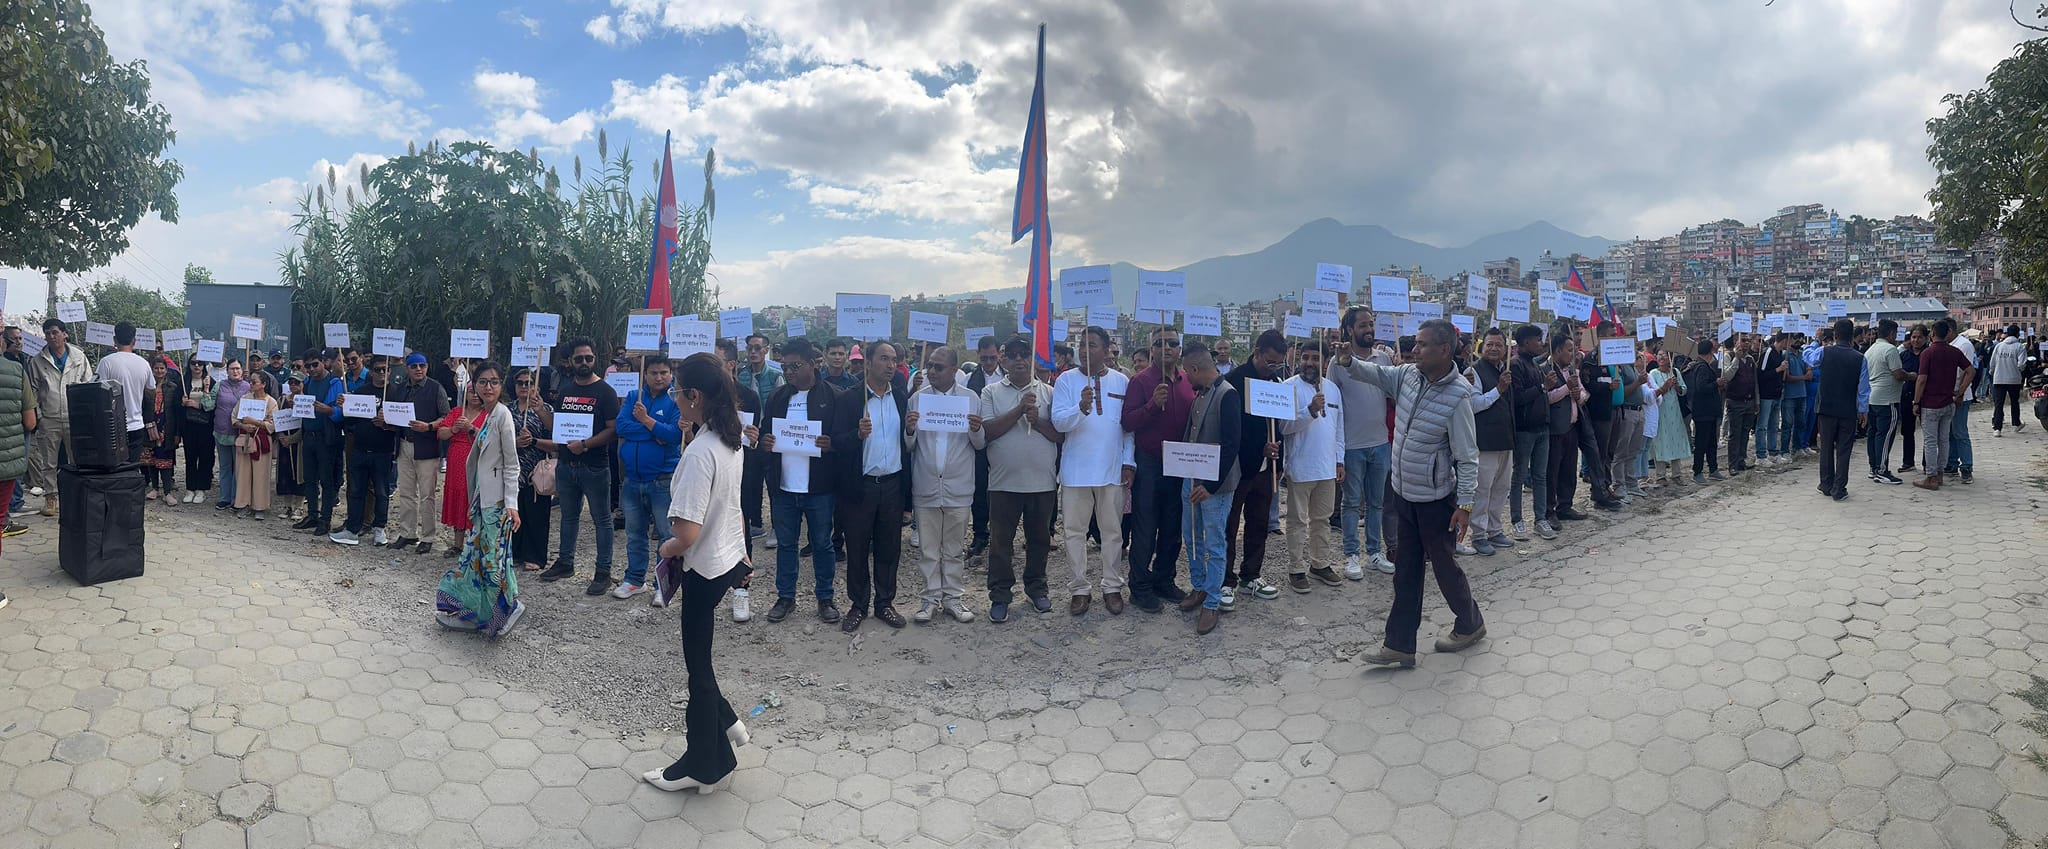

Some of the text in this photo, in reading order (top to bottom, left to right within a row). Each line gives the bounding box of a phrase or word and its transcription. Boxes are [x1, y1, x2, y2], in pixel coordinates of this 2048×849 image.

[844, 306, 863, 314] सहकारी
[561, 403, 593, 412] balance
[790, 424, 809, 432] सहकारी
